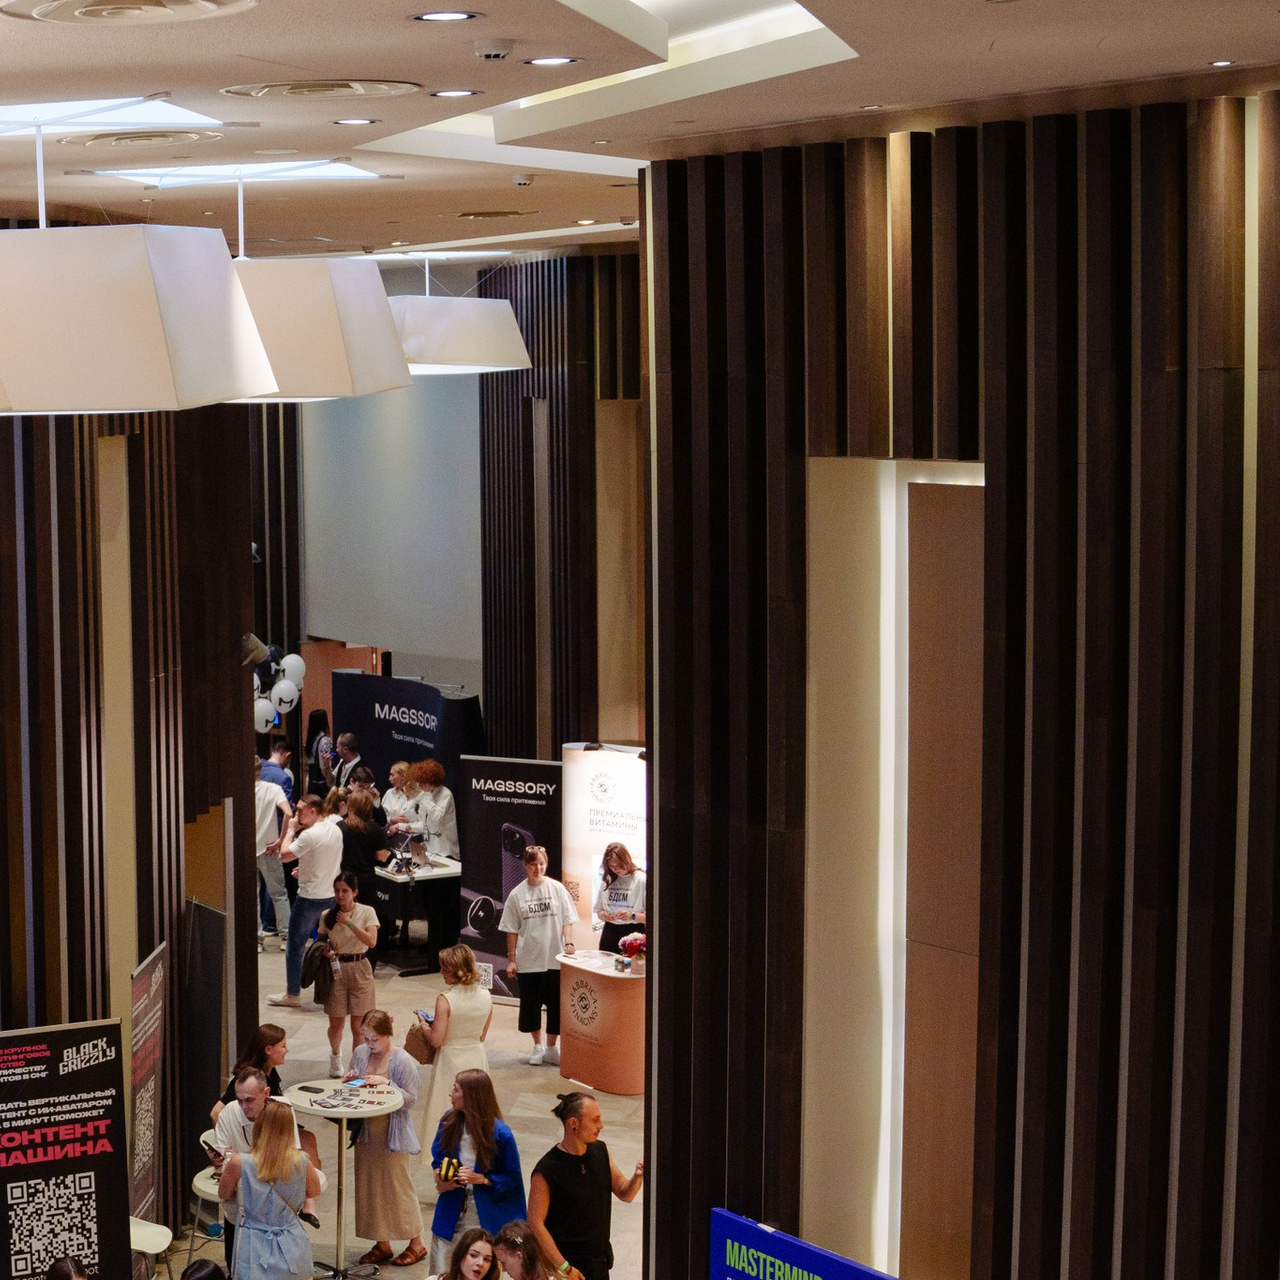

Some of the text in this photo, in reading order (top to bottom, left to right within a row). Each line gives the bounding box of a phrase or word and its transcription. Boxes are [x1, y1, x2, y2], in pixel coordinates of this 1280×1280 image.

[472, 778, 556, 796] MAGSSORY
[482, 794, 496, 802] Твоя
[511, 797, 546, 806] притяжения
[589, 809, 645, 823] ПРЕМИАЛЬН
[589, 818, 637, 831] ВИТАМИНЫ
[608, 892, 628, 902] БДСМ
[528, 902, 551, 913] БДСМ
[570, 980, 598, 1005] FABBRICA
[4, 1044, 47, 1055] КРУПНОЕ
[63, 1037, 107, 1062] BLACK
[59, 1046, 115, 1076] GRIZZLY
[30, 1071, 49, 1079] СНГ
[28, 1088, 116, 1106] ВЕРТИКАЛЬНЫЙ
[28, 1108, 37, 1116] С
[37, 1099, 112, 1114] ИИ-АВАТАРОМ
[11, 1116, 50, 1127] МИНУТ
[51, 1109, 105, 1122] ПОМОЖЕТ
